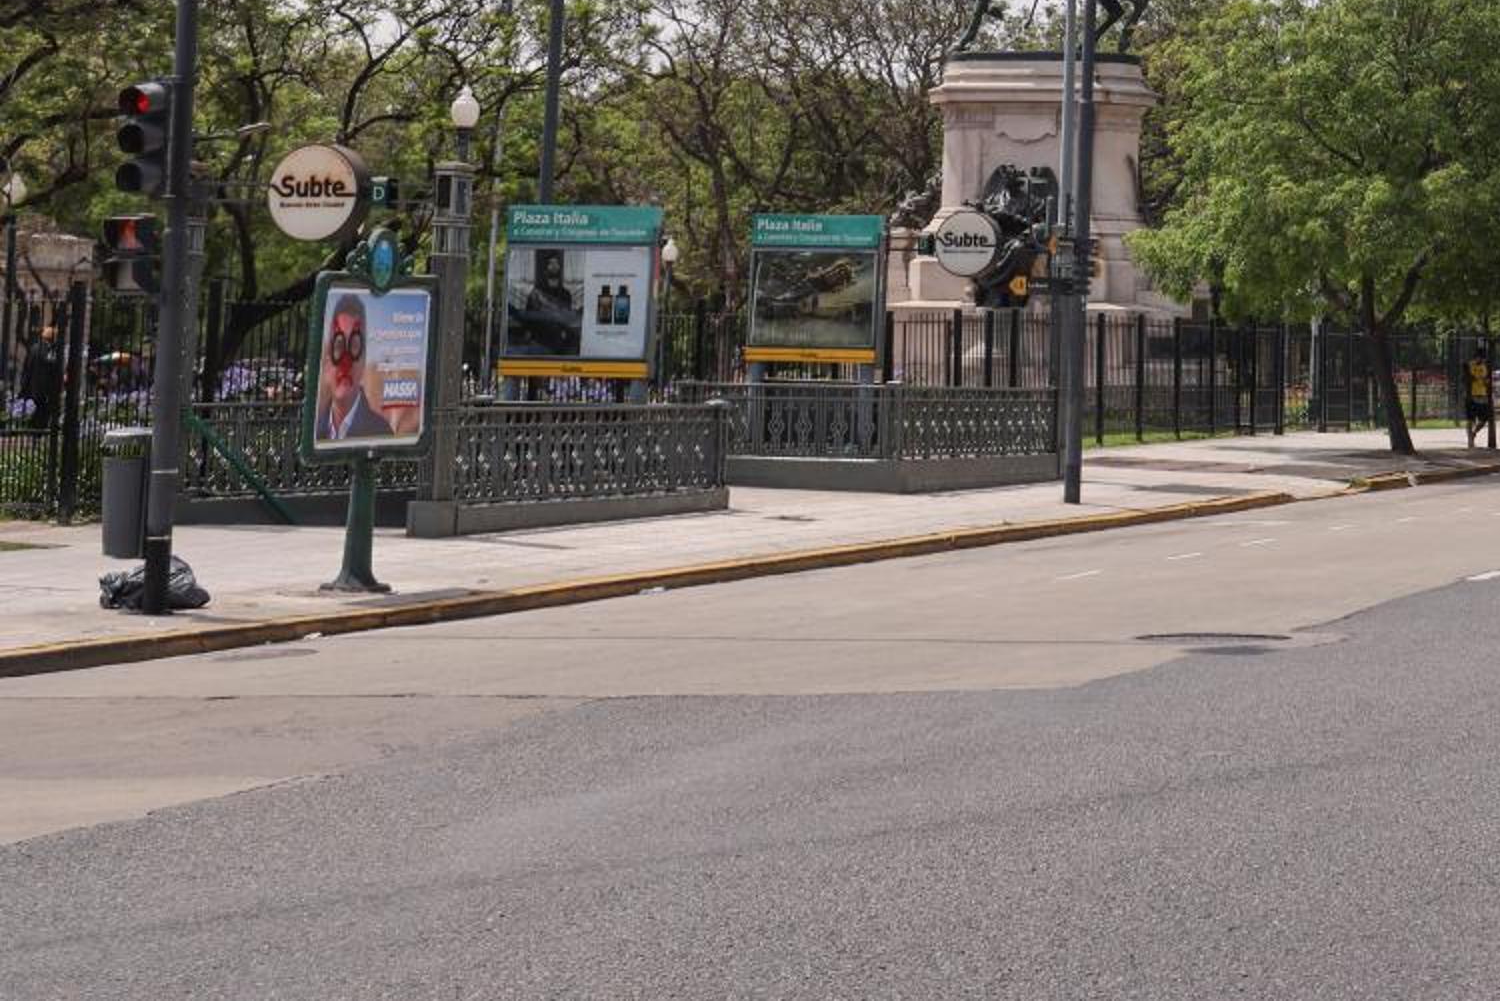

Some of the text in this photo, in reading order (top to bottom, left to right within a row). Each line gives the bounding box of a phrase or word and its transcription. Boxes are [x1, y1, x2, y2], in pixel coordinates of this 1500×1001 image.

[272, 175, 355, 198] Subte
[373, 185, 385, 200] D
[513, 210, 589, 225] Plaza Italia
[757, 218, 823, 232] Plaza Italia
[937, 232, 994, 248] Subte
